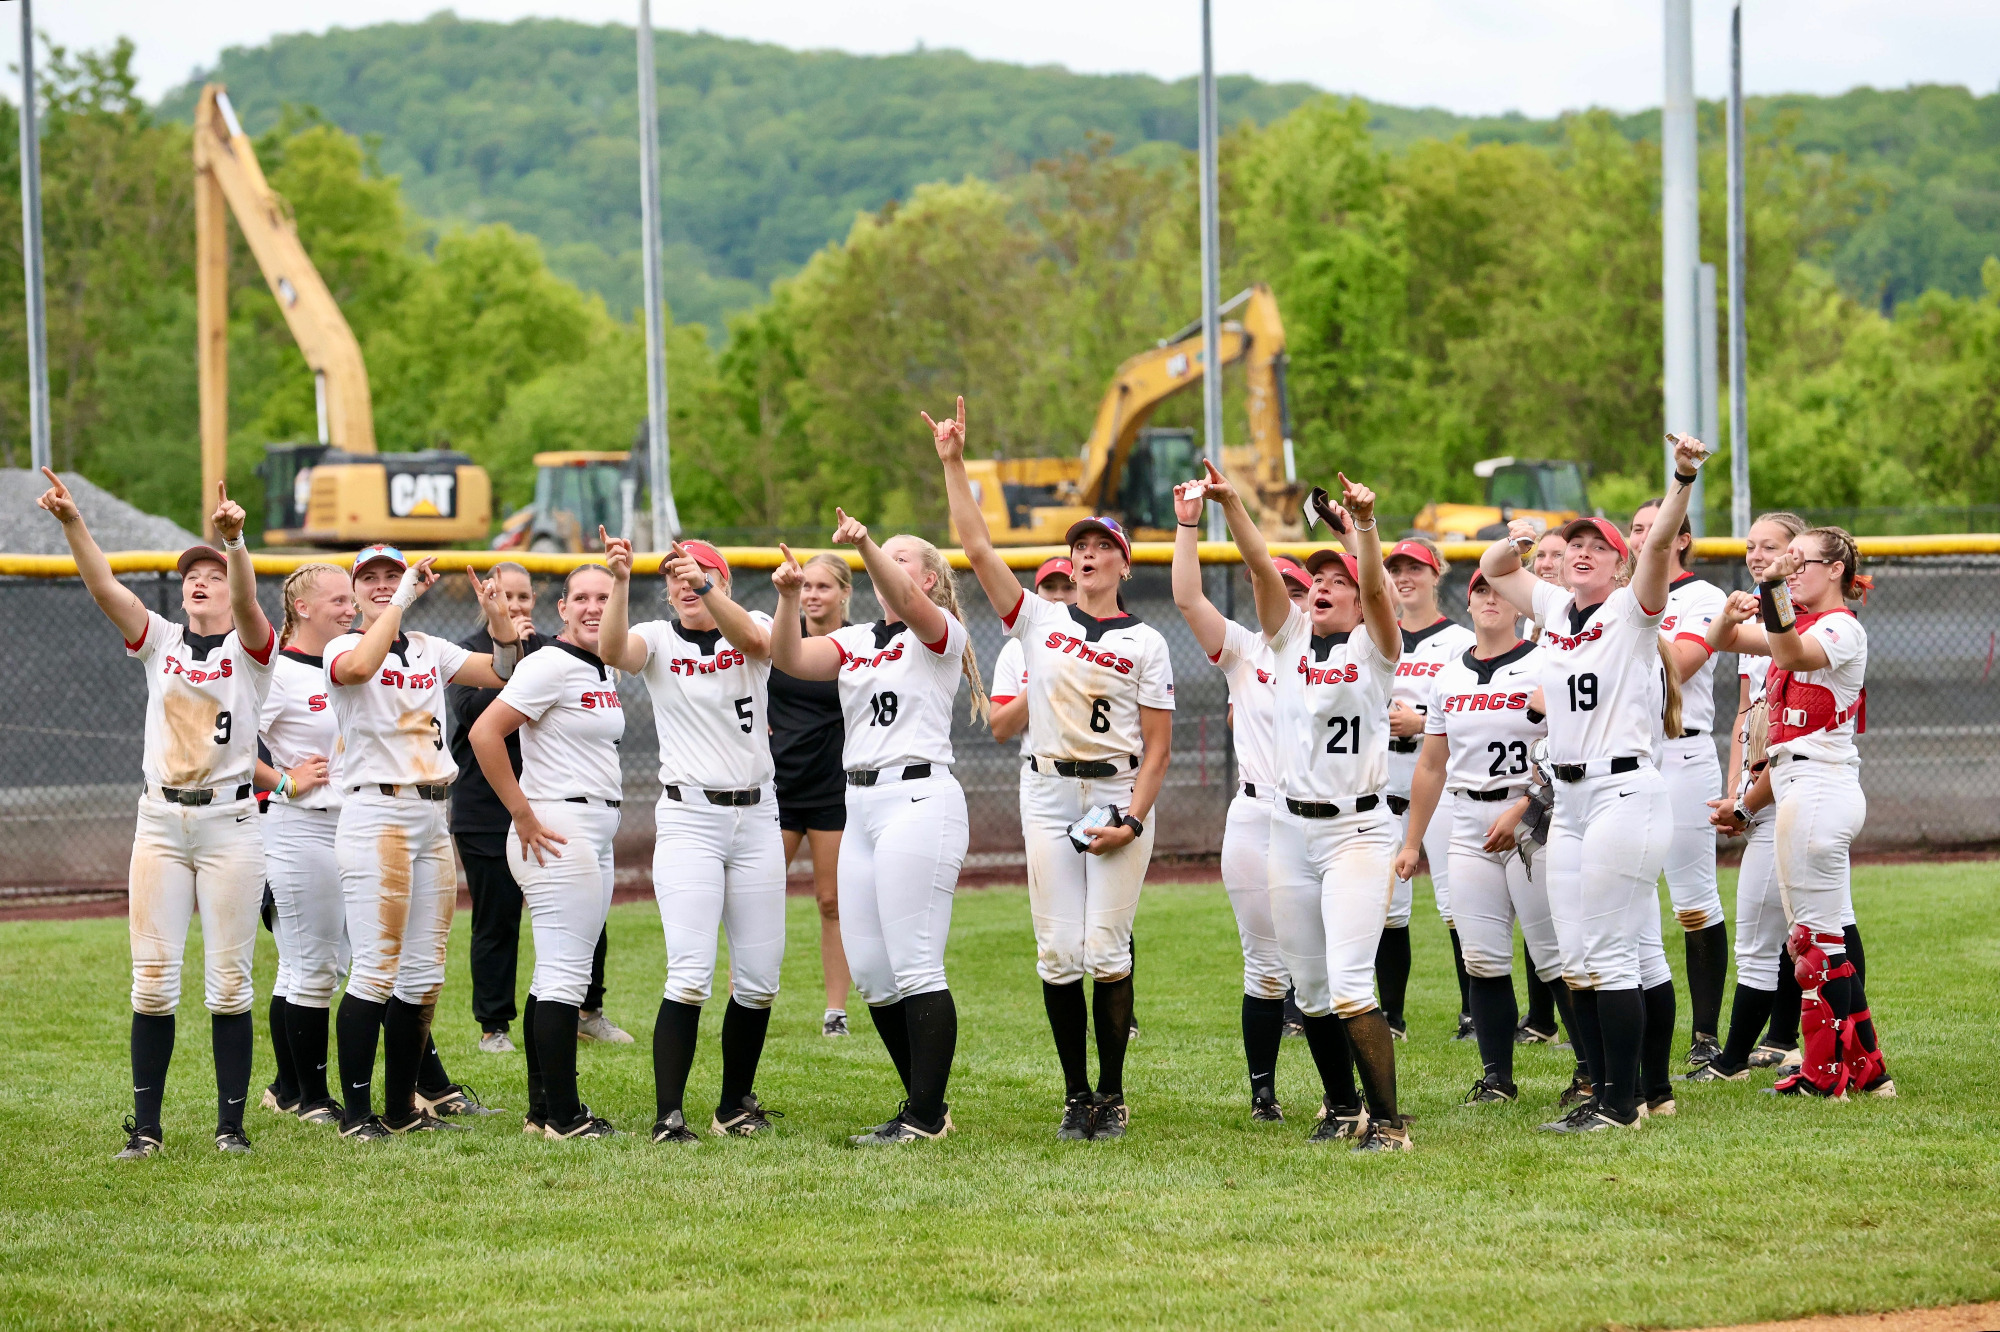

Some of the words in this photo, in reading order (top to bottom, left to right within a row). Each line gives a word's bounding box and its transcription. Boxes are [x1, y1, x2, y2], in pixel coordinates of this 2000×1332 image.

[391, 473, 455, 517] CAT
[1401, 543, 1412, 551] F
[870, 691, 898, 727] 18
[1442, 692, 1528, 714] STAGS
[1567, 672, 1599, 712] 19
[214, 711, 232, 745] 9
[734, 696, 753, 734] 5
[1089, 698, 1111, 734] 6
[1326, 715, 1361, 754] 21
[1487, 741, 1528, 777] 23
